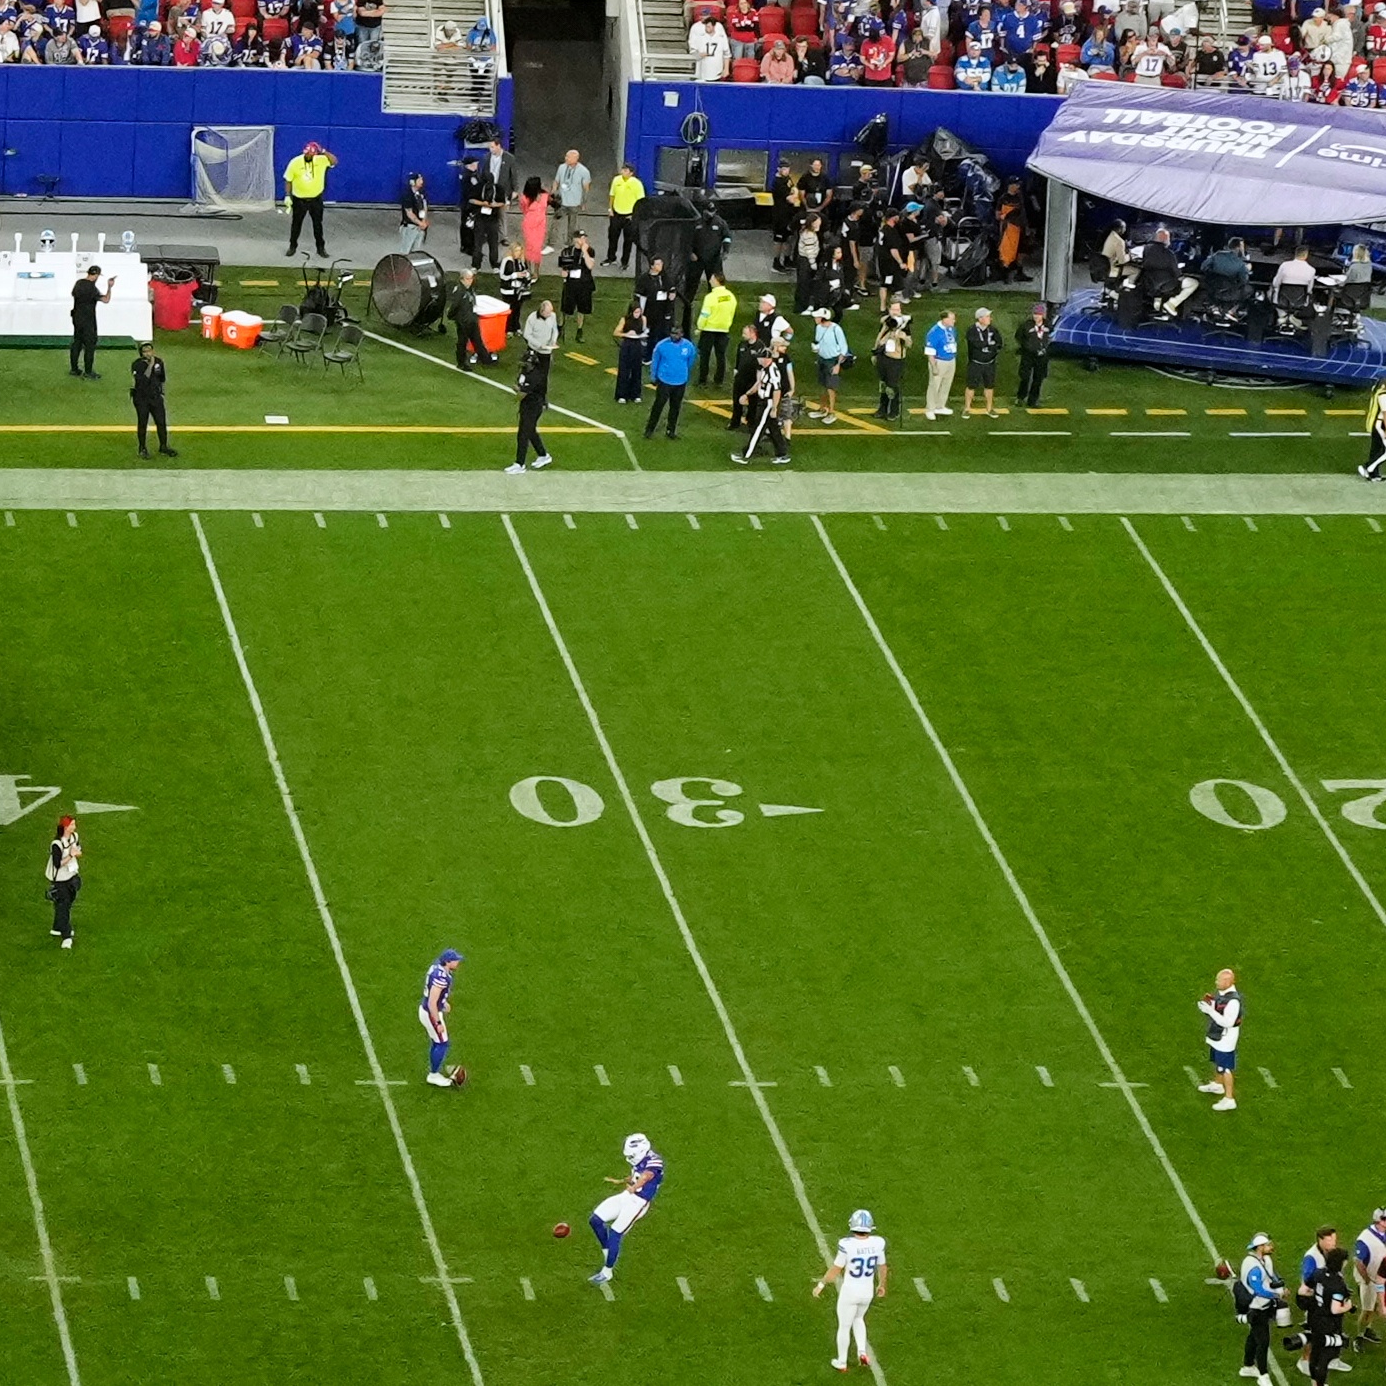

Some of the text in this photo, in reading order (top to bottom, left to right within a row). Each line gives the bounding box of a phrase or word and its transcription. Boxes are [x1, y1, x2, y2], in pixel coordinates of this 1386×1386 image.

[1100, 108, 1299, 138] FOOTBALL
[1160, 125, 1279, 149] NIGHT
[1058, 130, 1269, 159] THURSDAY
[1317, 148, 1386, 168] ime
[509, 775, 745, 828] 30
[1189, 778, 1386, 831] 20
[849, 1256, 877, 1277] 39
